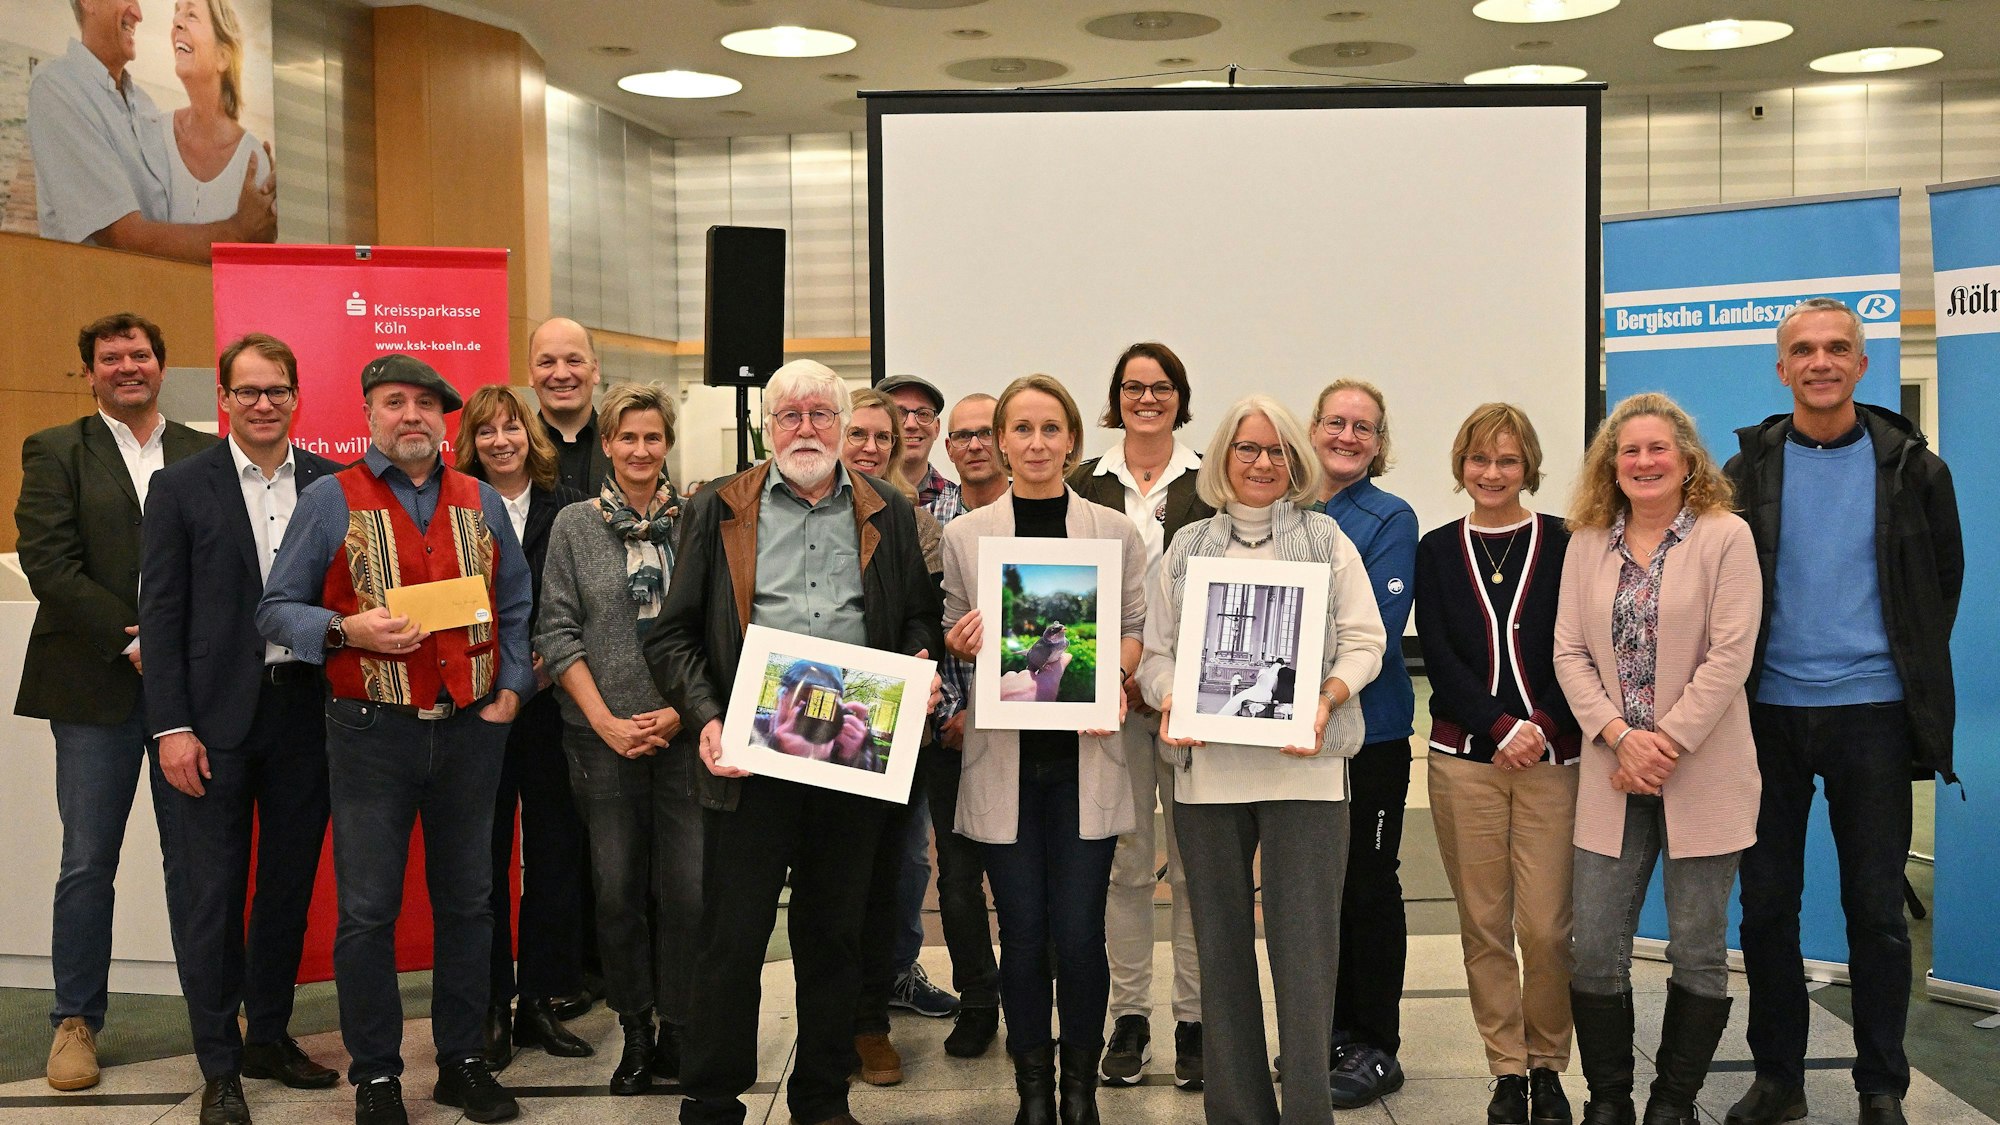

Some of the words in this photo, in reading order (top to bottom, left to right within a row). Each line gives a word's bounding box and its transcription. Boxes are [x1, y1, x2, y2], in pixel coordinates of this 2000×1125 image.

[374, 304, 481, 319] Kreissparkasse
[1862, 296, 1889, 315] R
[1616, 305, 1703, 334] Bergische
[1709, 298, 1845, 326] Landesze
[375, 321, 407, 334] Köln
[375, 340, 481, 351] www.ksk-koeln.de
[291, 437, 330, 454] lich
[335, 437, 454, 454] willn.
